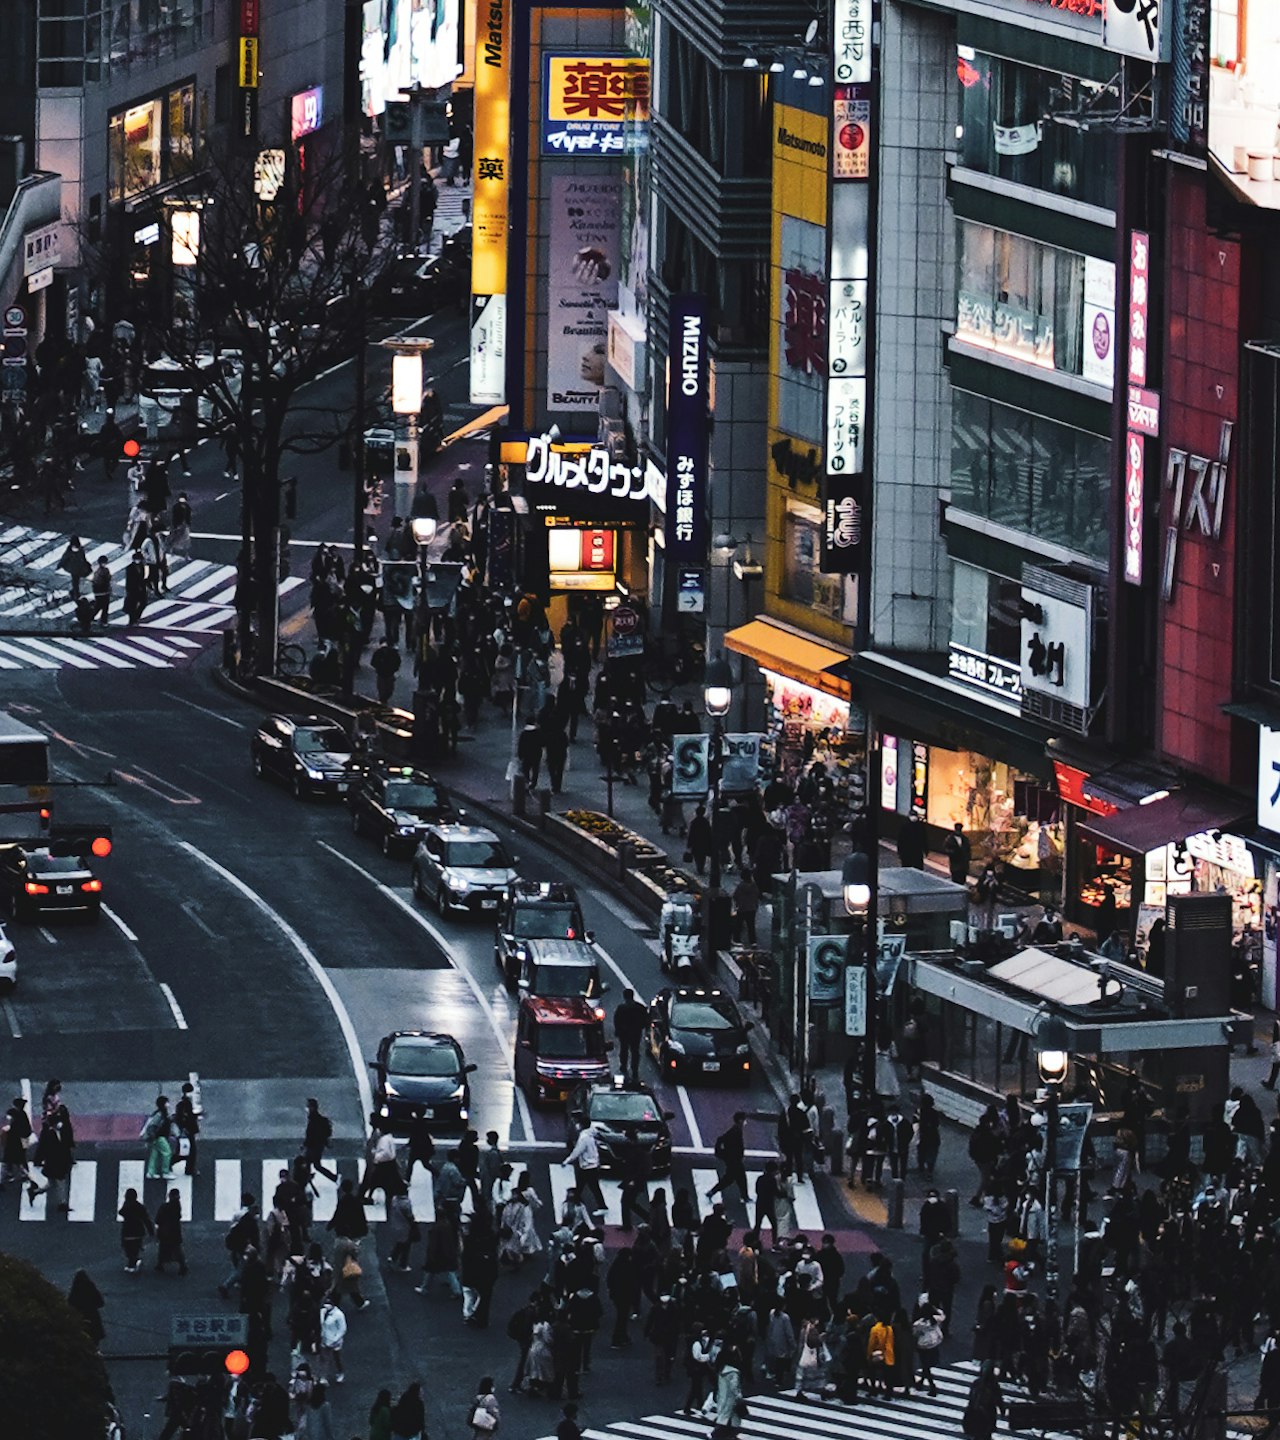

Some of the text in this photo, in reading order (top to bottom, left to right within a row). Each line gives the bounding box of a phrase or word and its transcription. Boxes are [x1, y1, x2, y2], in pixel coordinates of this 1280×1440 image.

[777, 126, 826, 158] Matsumoto
[477, 156, 505, 182] 薬
[835, 306, 847, 354] パーラー
[849, 299, 862, 348] フルーツ
[681, 315, 701, 396] MIZUHO
[526, 437, 651, 500] グルメタウン
[674, 456, 695, 541] みずほ銀行
